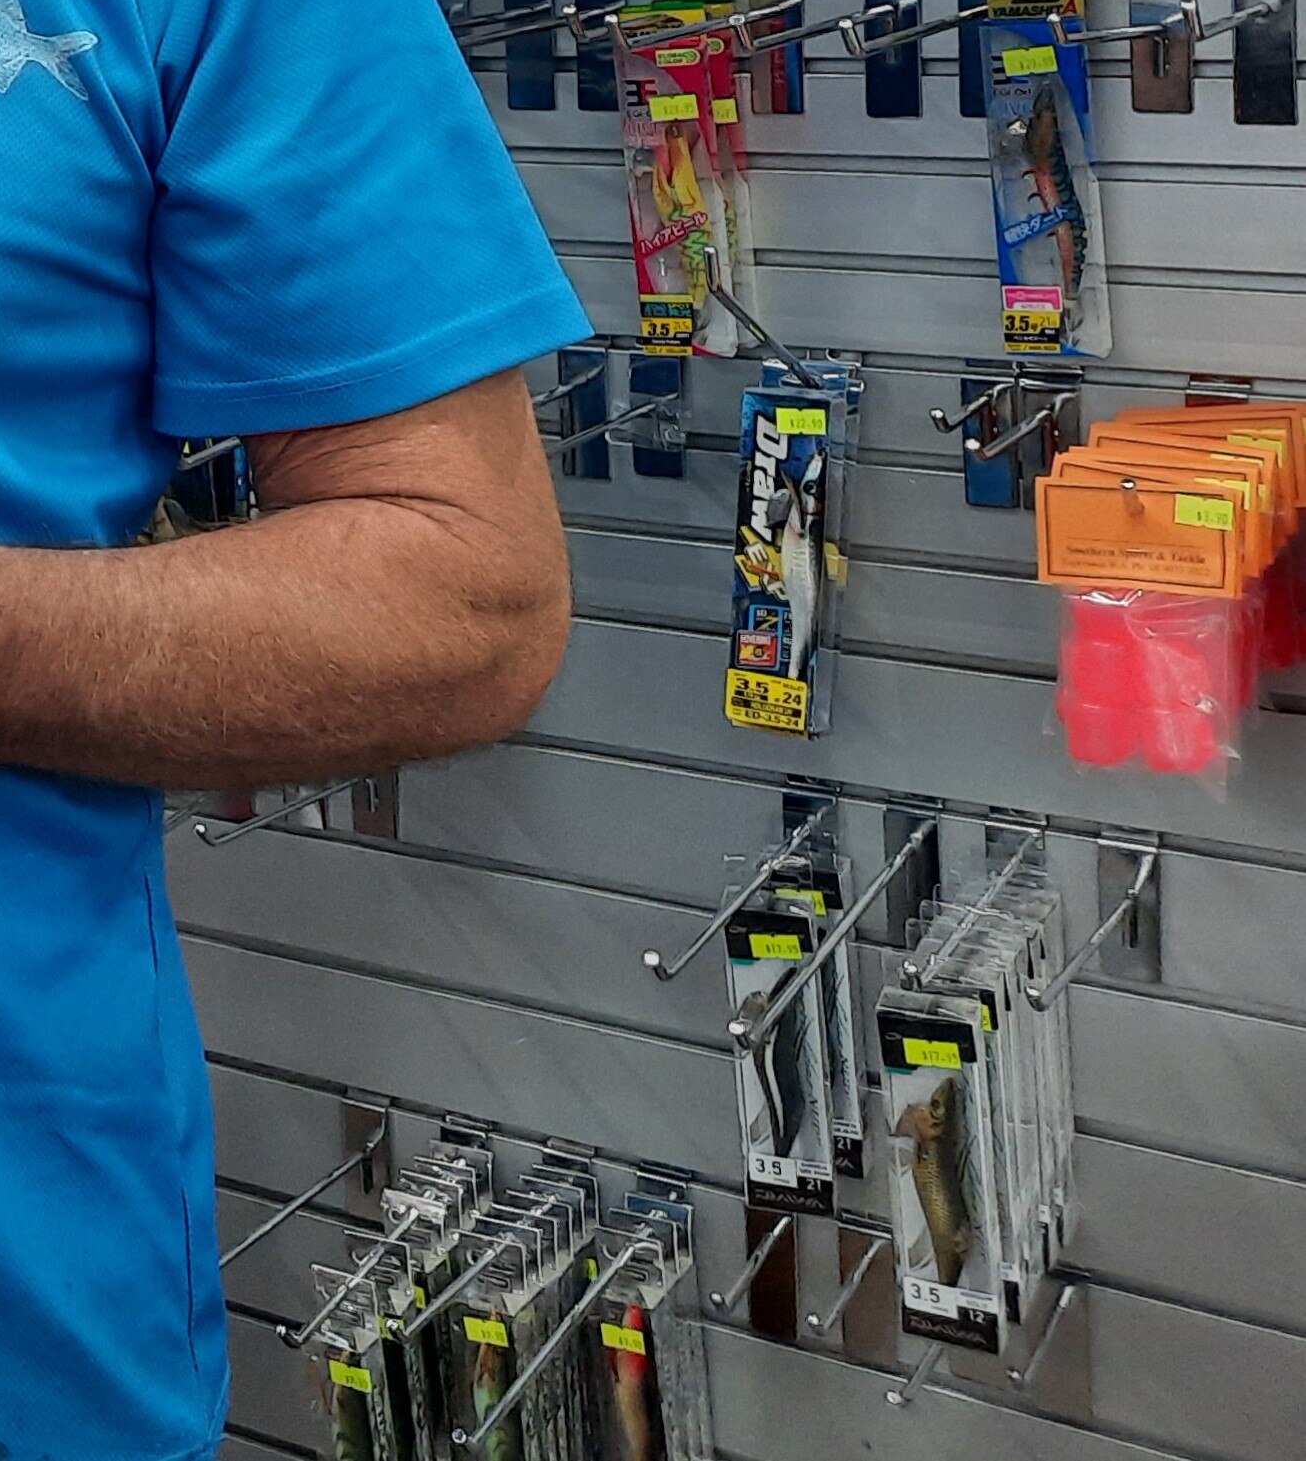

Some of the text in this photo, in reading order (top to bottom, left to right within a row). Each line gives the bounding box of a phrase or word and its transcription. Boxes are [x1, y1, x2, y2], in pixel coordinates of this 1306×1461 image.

[647, 321, 671, 337] 3.5
[1004, 314, 1030, 333] 3.5
[790, 419, 822, 429] $22.90
[751, 415, 787, 542] Draw
[1066, 547, 1115, 557] Southern
[1171, 553, 1205, 564] Tackle
[735, 678, 769, 694] 3.5
[782, 692, 802, 706] 24
[755, 1159, 783, 1177] 3.5
[806, 1178, 822, 1191] 21
[909, 1284, 941, 1303] 3.5
[970, 1308, 985, 1323] 12
